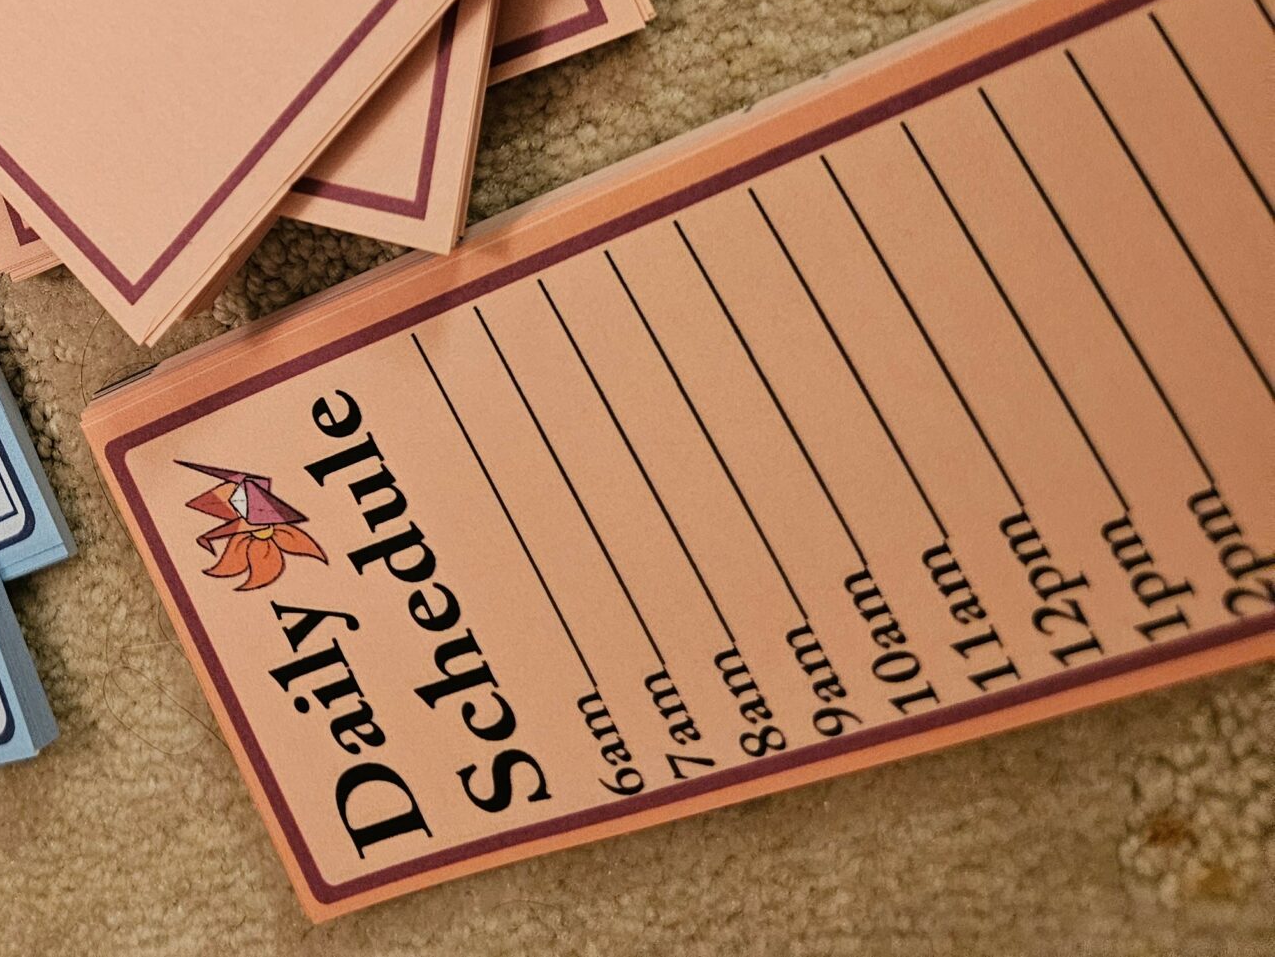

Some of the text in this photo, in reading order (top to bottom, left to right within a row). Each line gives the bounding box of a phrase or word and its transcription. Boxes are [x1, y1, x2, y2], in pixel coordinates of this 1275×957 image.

[304, 389, 553, 813] Schedule
[999, 509, 1104, 667] 12pm
[1100, 515, 1195, 641] 1pm
[1187, 487, 1275, 617] 2pm
[785, 623, 863, 738] 9am
[843, 568, 940, 714] 10am
[921, 543, 1021, 692] 11am
[268, 600, 433, 859] Daily
[576, 691, 645, 797] 6am
[643, 669, 716, 780] 7am
[713, 646, 787, 758] 8am
